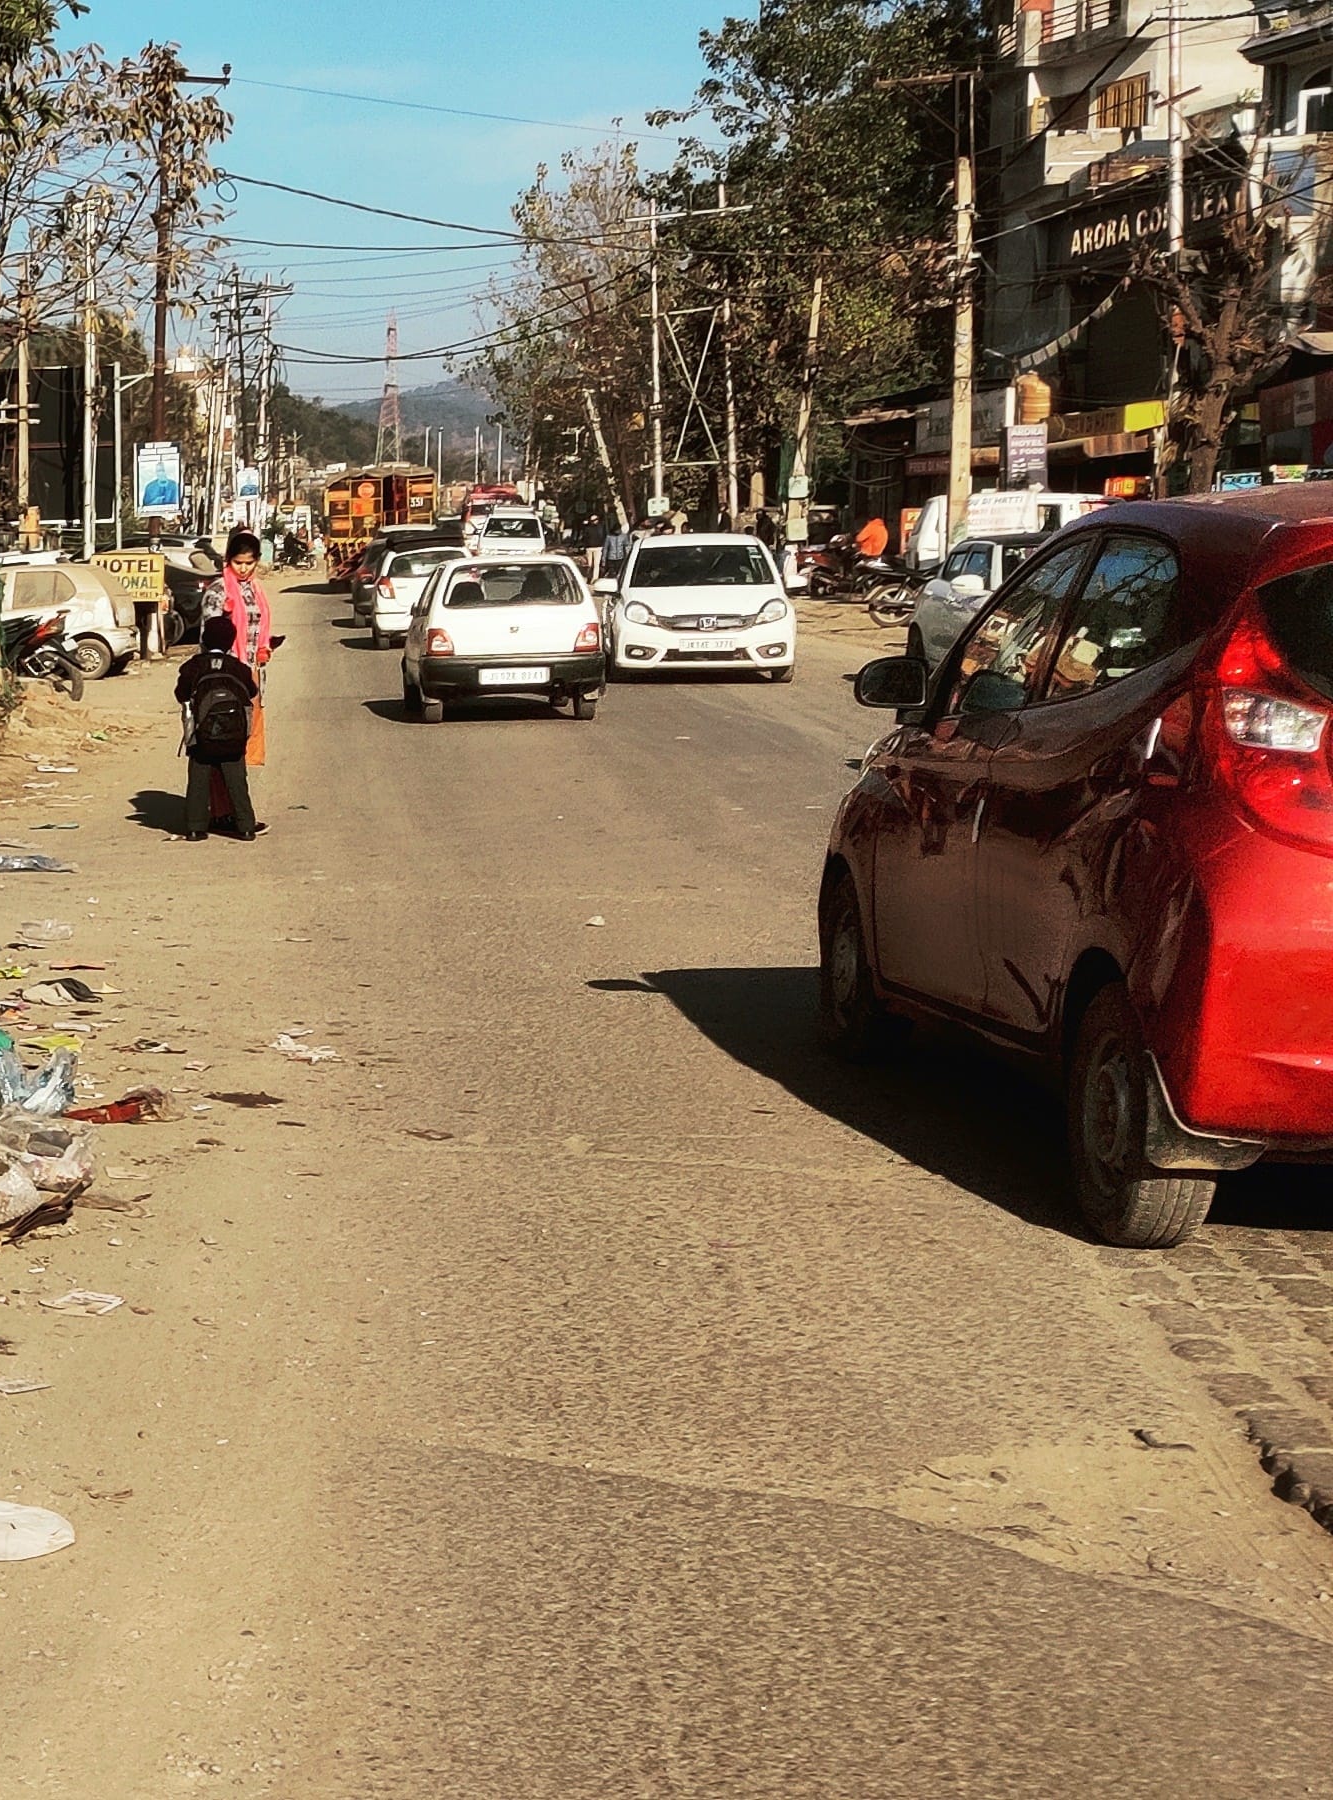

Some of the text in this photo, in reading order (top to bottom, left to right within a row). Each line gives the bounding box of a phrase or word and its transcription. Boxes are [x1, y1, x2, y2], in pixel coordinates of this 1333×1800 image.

[1070, 182, 1230, 257] ARORA COLEX
[117, 576, 158, 589] ONAL
